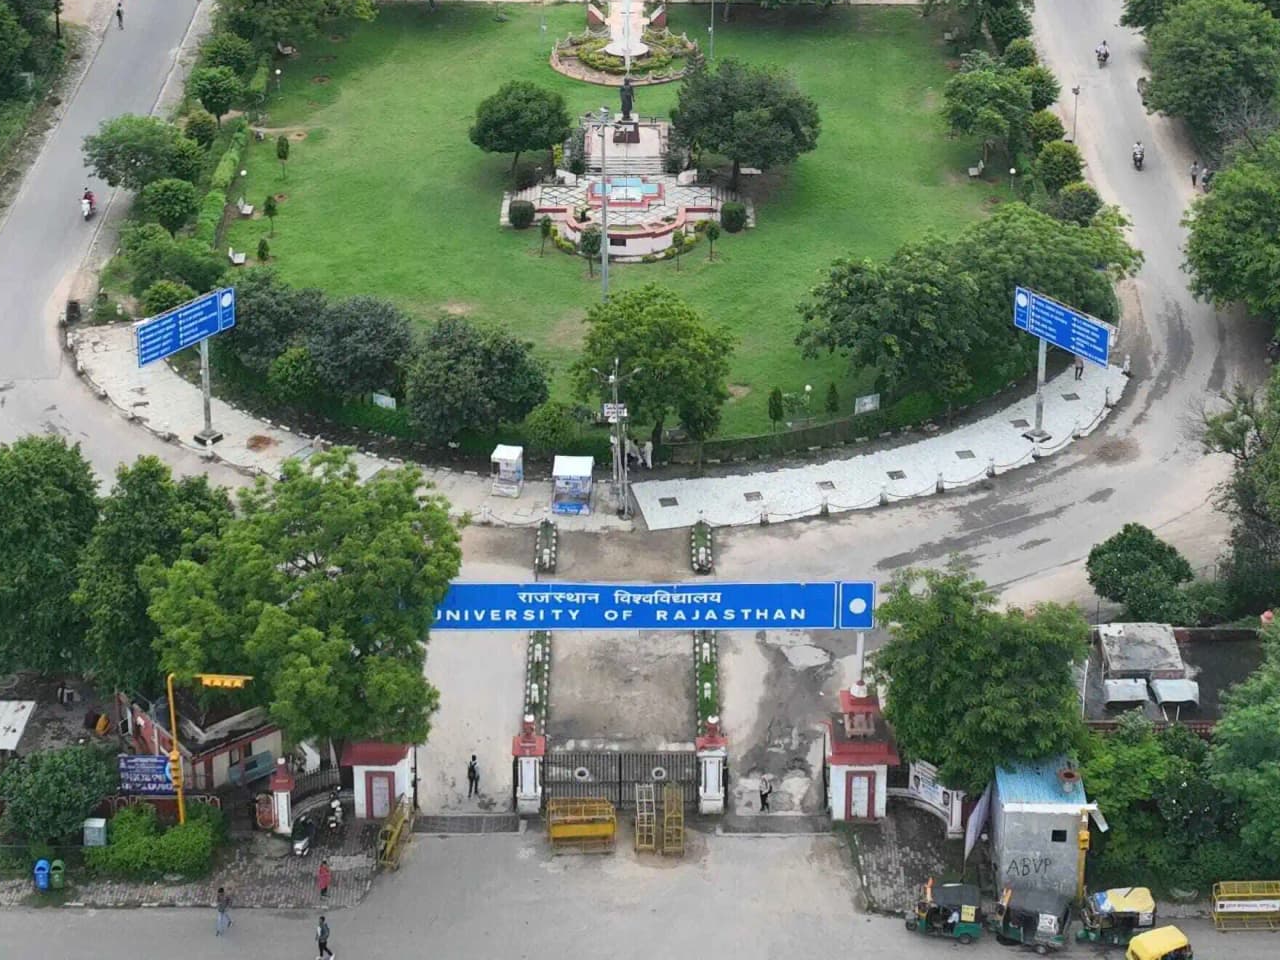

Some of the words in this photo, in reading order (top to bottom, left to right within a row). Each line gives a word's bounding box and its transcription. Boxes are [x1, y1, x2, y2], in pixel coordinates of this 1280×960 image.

[518, 591, 599, 604] राजस्थान
[614, 589, 721, 605] विश्वविद्यालय
[604, 609, 632, 621] OF
[656, 609, 805, 620] RAJASTHAN
[1006, 855, 1052, 877] ABVP
